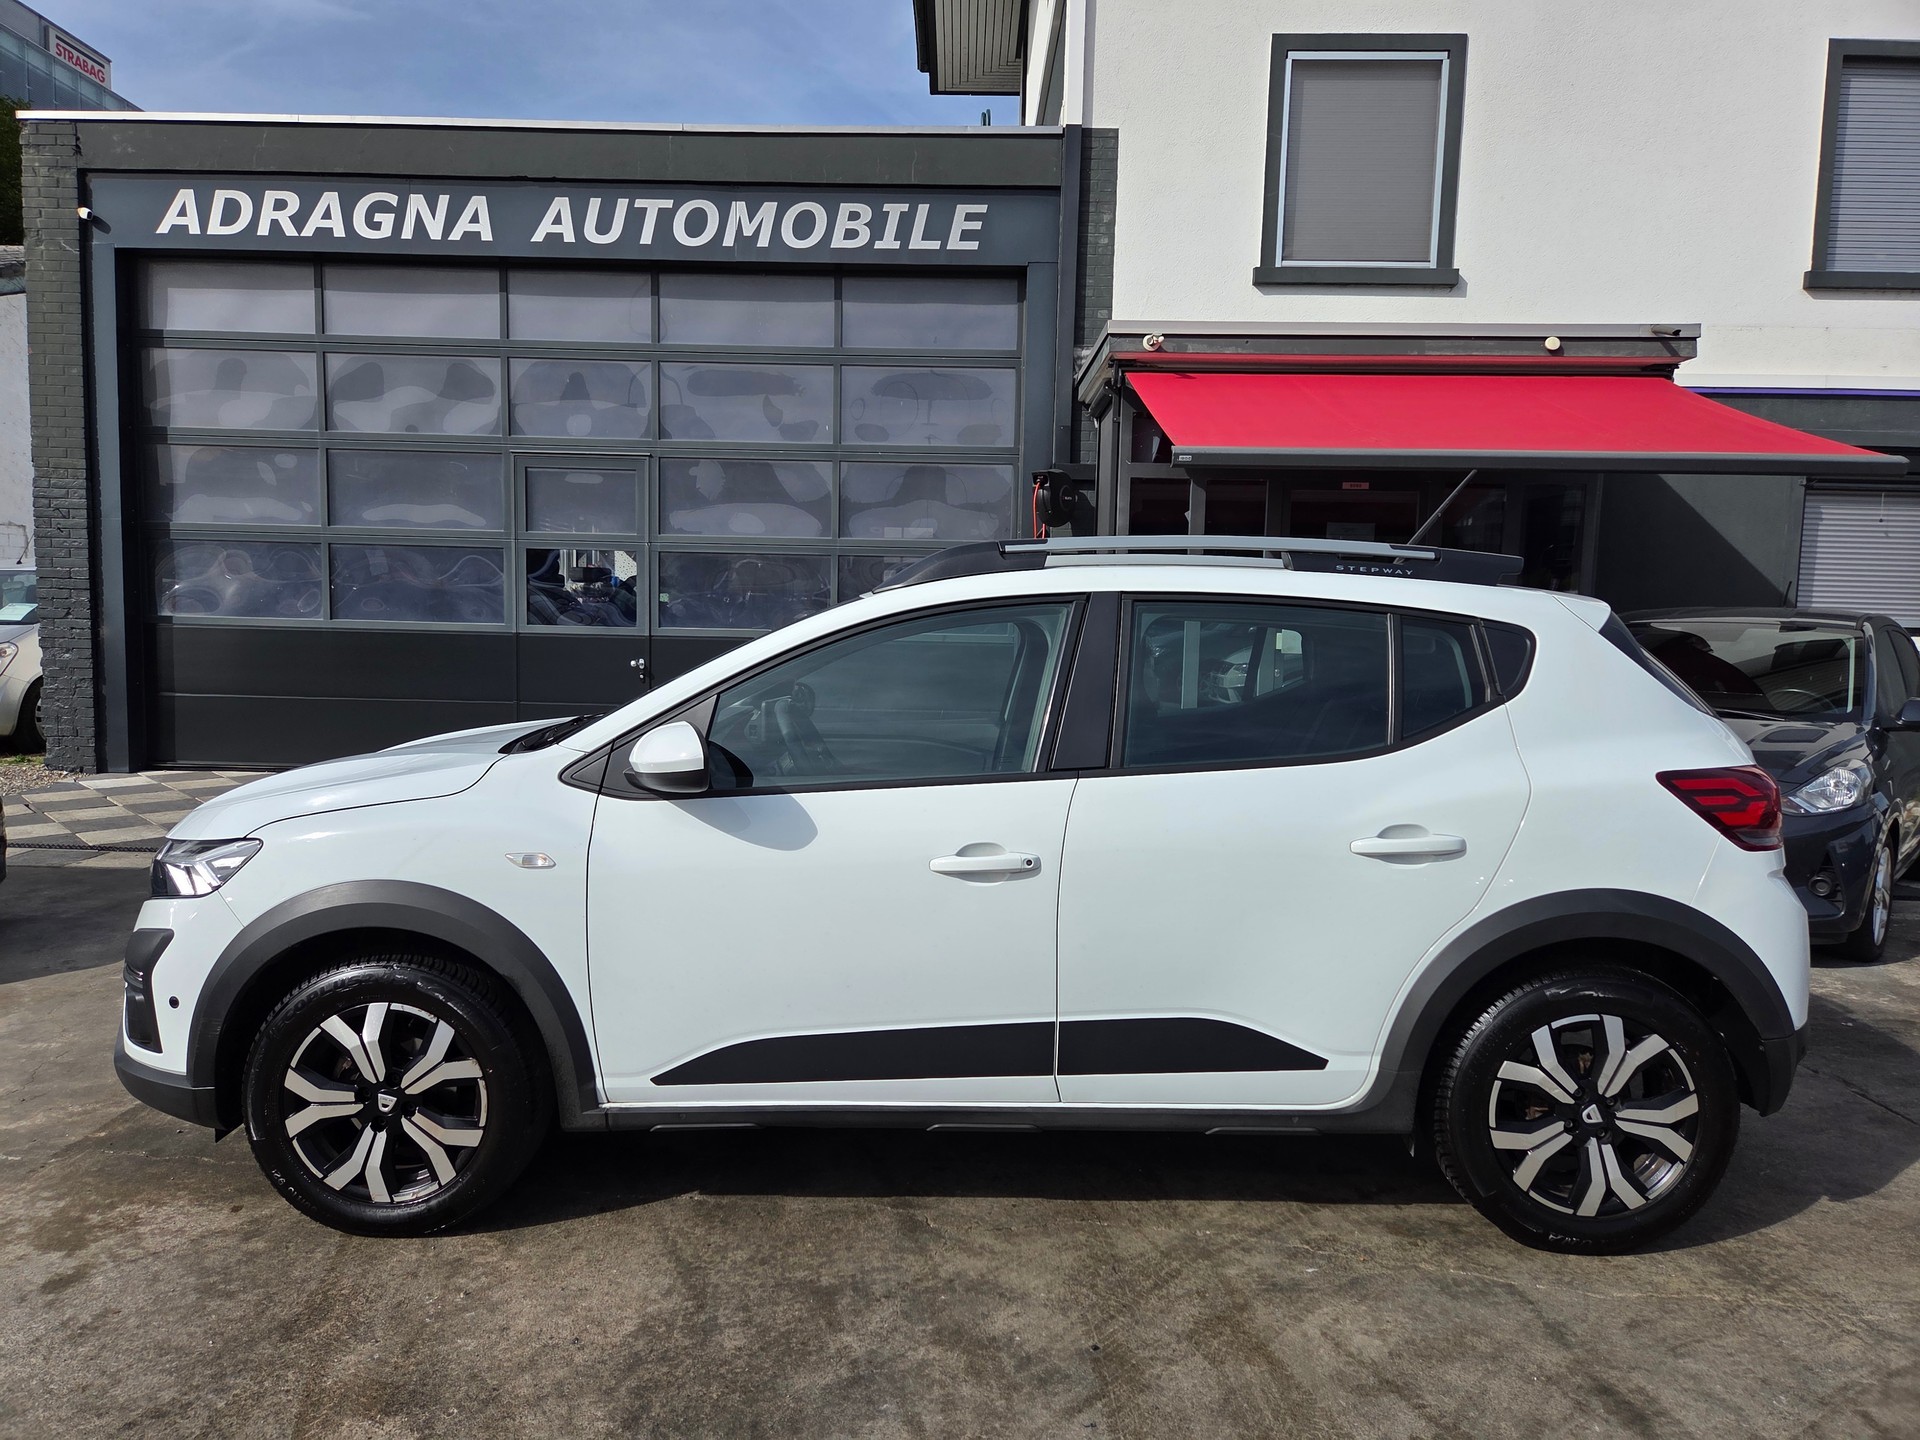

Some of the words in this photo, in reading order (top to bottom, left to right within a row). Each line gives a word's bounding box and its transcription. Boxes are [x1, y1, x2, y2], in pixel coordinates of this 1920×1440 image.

[55, 42, 106, 83] STRABAG
[156, 188, 493, 241] ADRAGNA
[530, 196, 988, 250] AUTOMOBILE
[1335, 564, 1413, 575] STEPWAY
